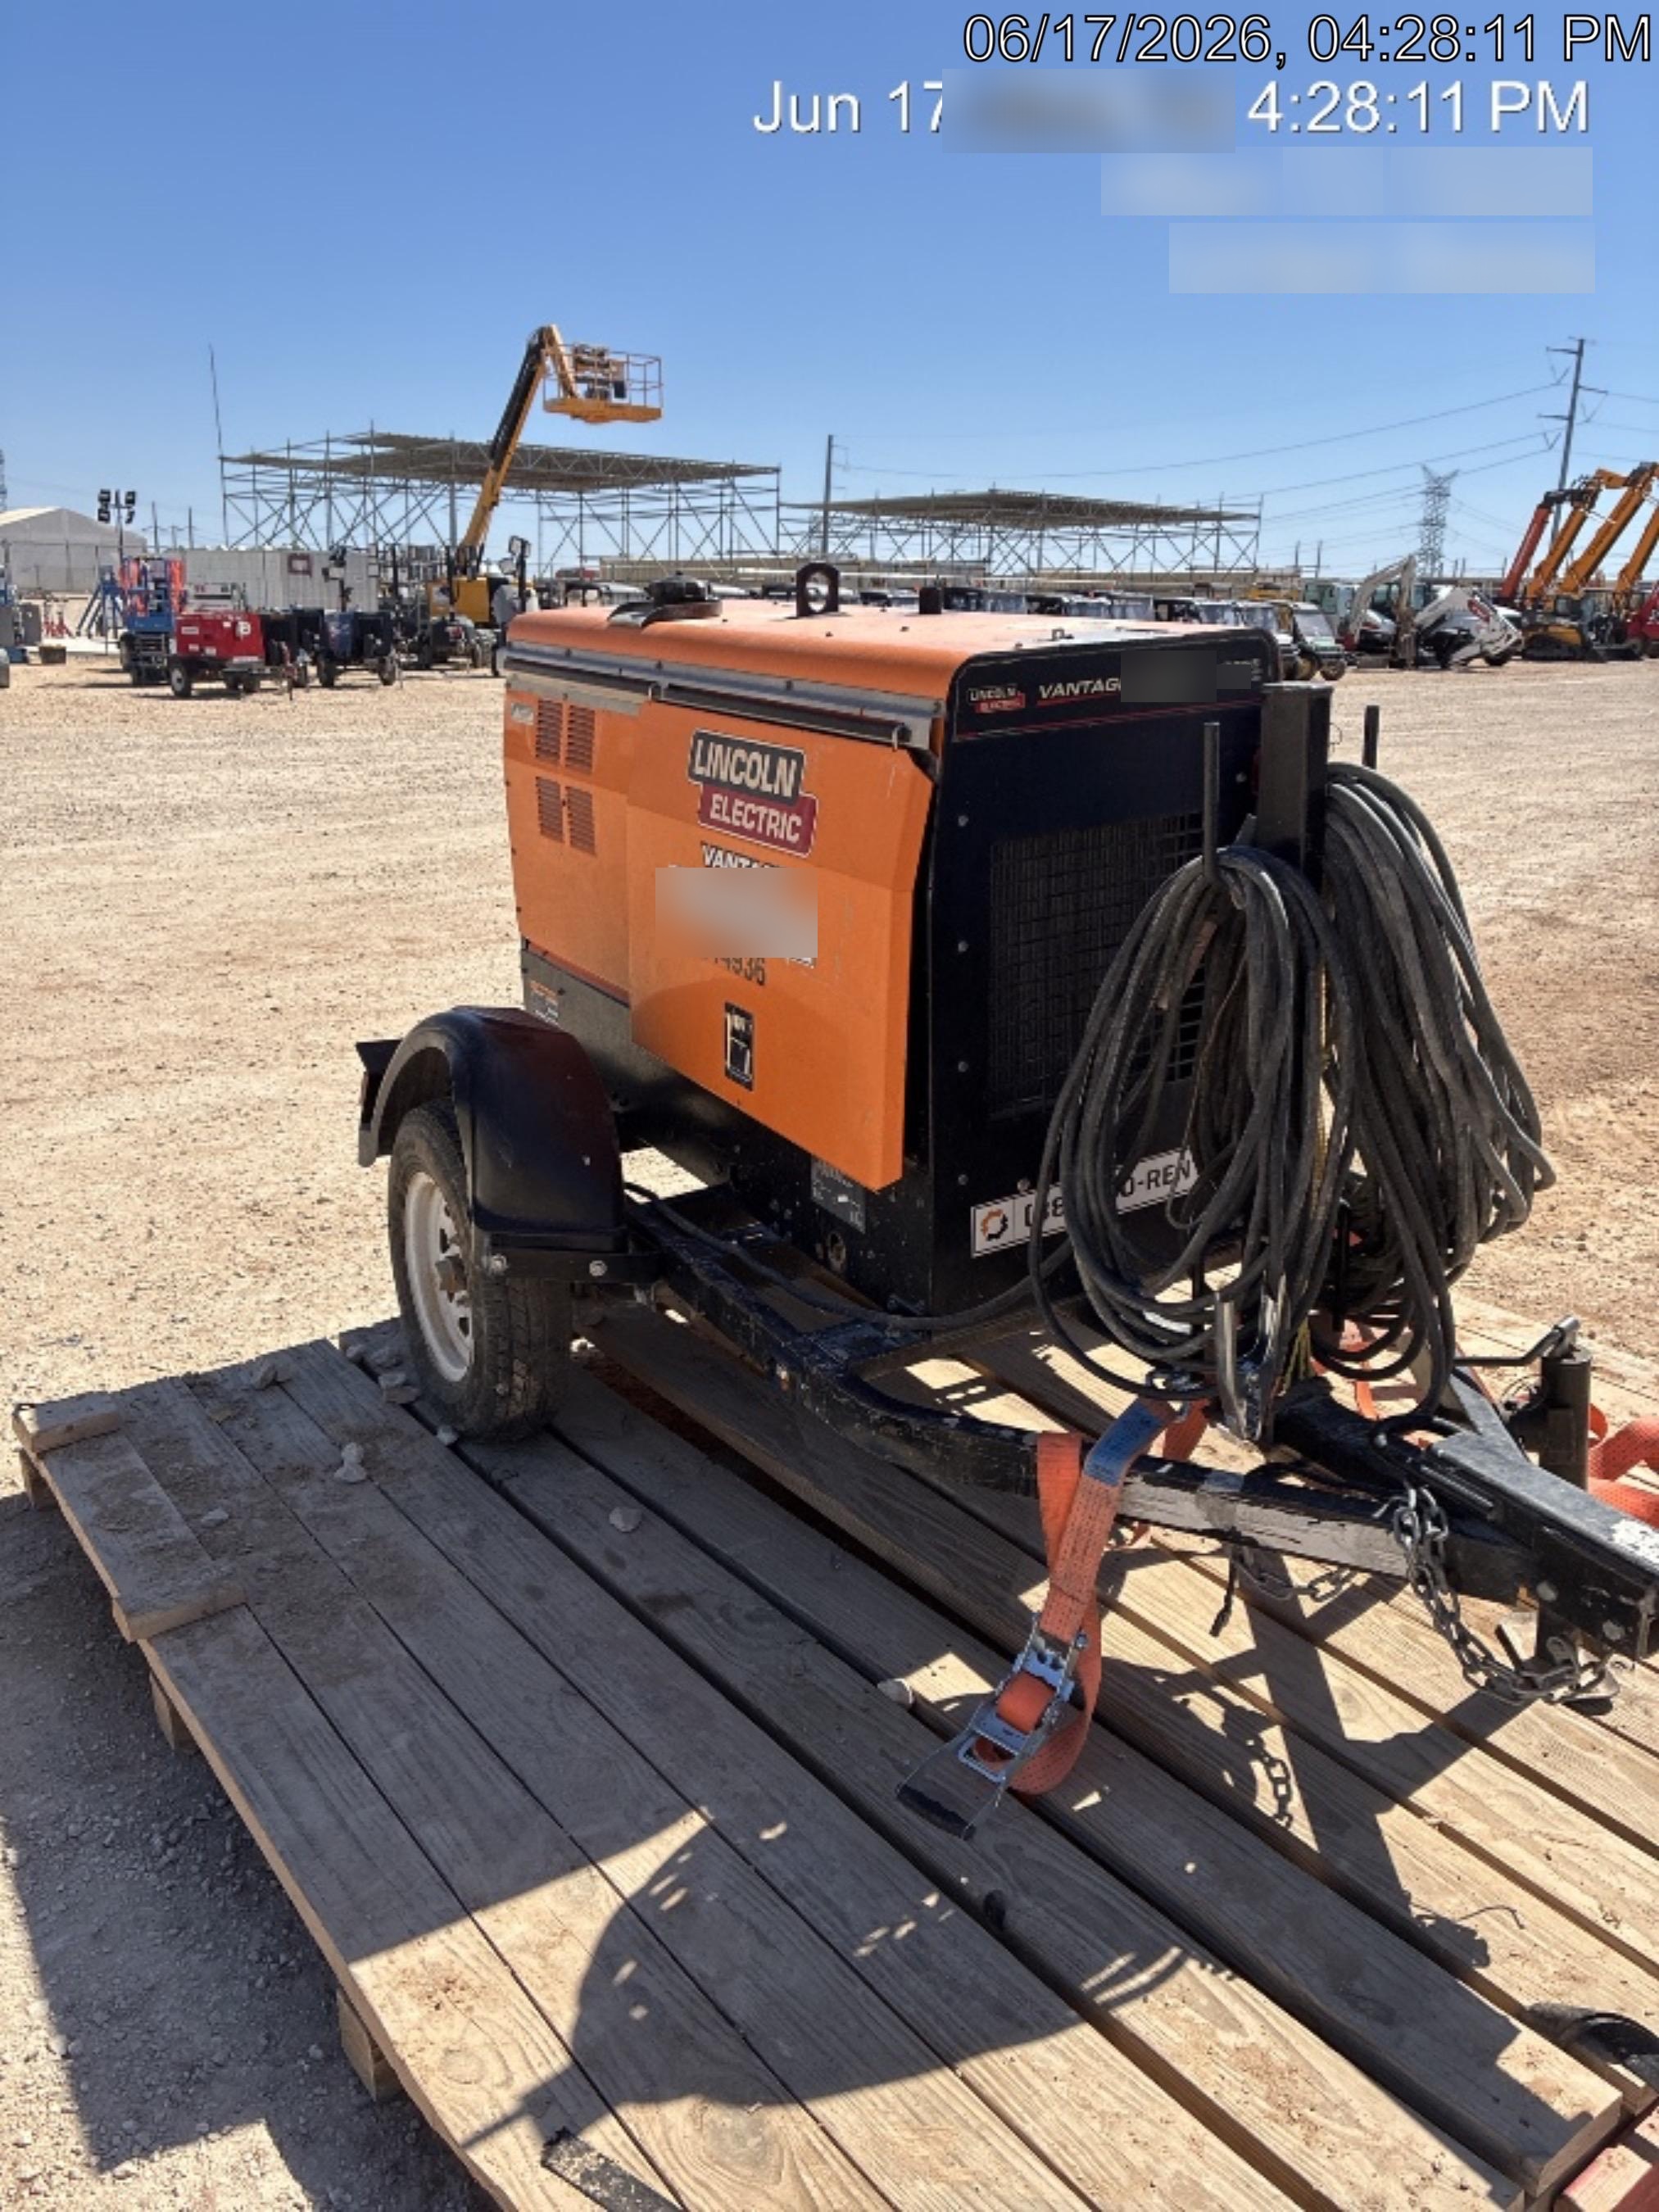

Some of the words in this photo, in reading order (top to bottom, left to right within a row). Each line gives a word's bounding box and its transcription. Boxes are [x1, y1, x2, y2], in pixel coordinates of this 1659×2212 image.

[1038, 677, 1121, 700] VANTAG
[694, 739, 798, 798] LINCOLN
[709, 793, 802, 844] ELECTRIC
